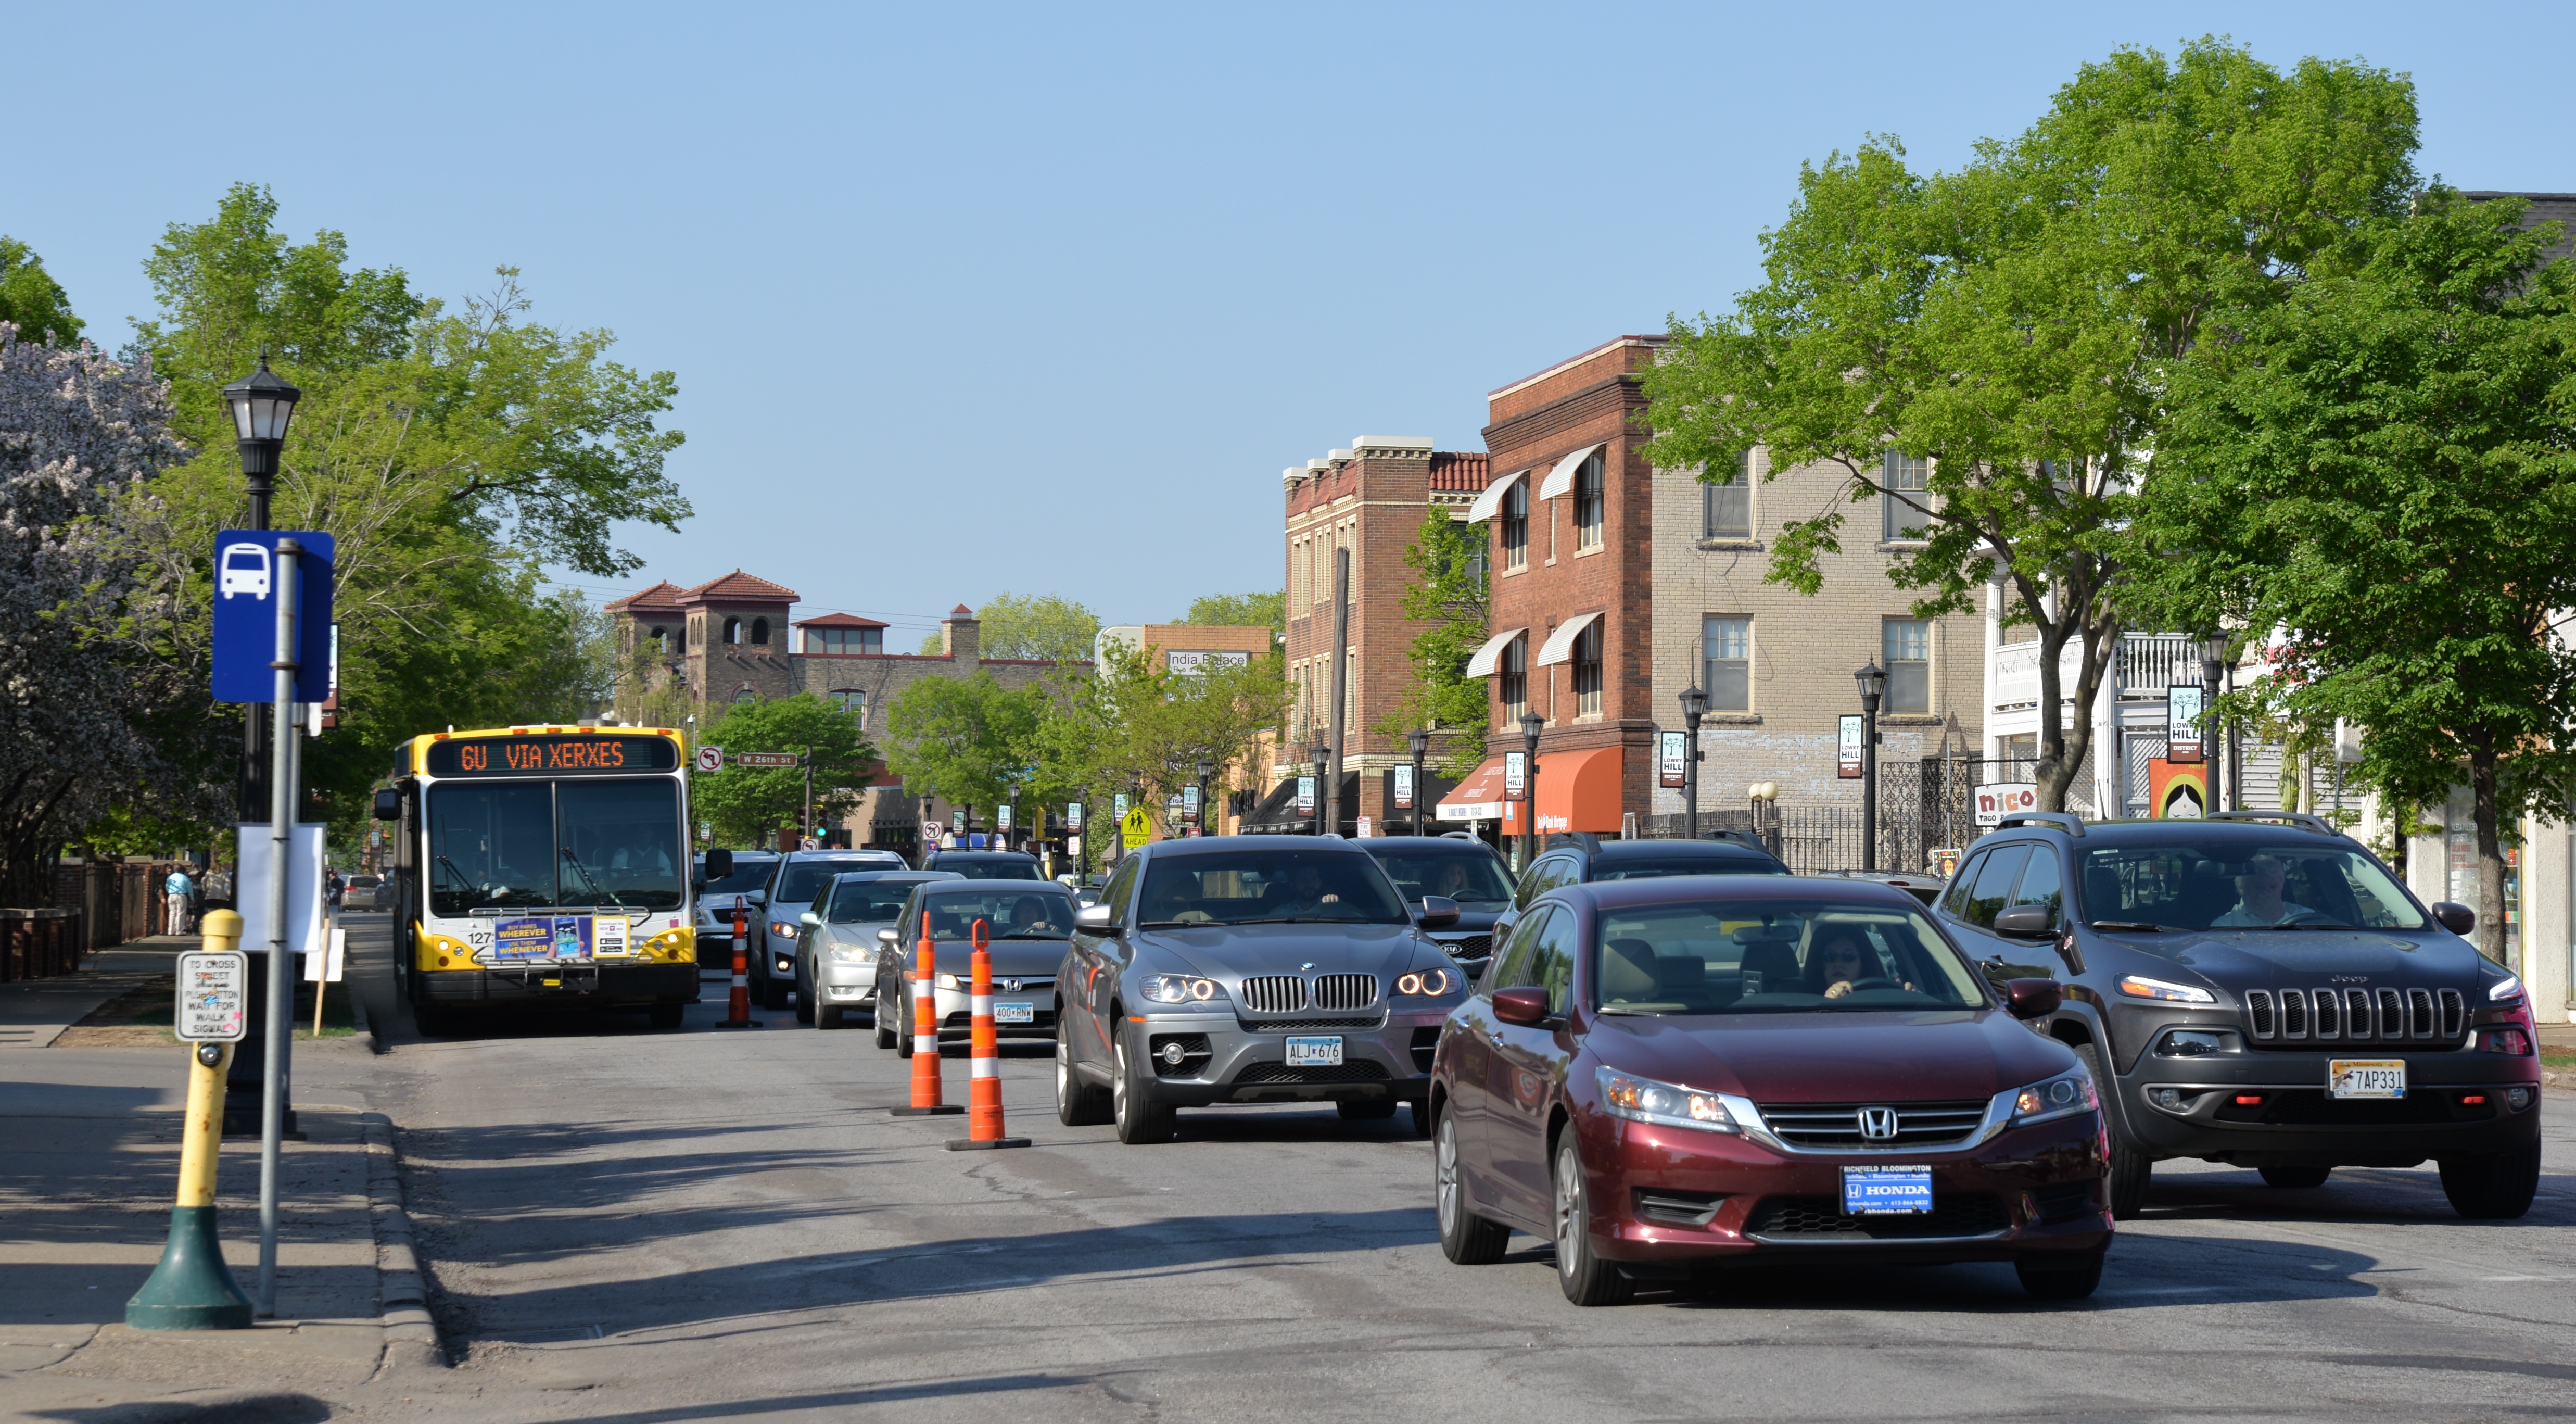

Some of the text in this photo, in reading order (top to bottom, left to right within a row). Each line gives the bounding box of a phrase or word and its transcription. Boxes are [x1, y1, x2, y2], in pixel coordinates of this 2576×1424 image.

[1168, 653, 1245, 665] India Place
[2173, 729, 2198, 739] HILL
[462, 742, 624, 770] 6U VIA XERXES
[468, 932, 494, 944] 127
[499, 928, 547, 938] WHEREVER
[499, 945, 548, 954] WHENEVER
[2331, 975, 2369, 984] Jeep
[186, 990, 239, 999] PUS UTTON
[188, 1002, 235, 1010] WAIT FOR
[997, 1007, 1031, 1017] 400 RNW
[194, 1025, 229, 1033] SIGNAL
[1290, 1044, 1339, 1058] ALJ 676
[2356, 1070, 2403, 1089] 7AP331
[1866, 1185, 1930, 1195] HONDA
